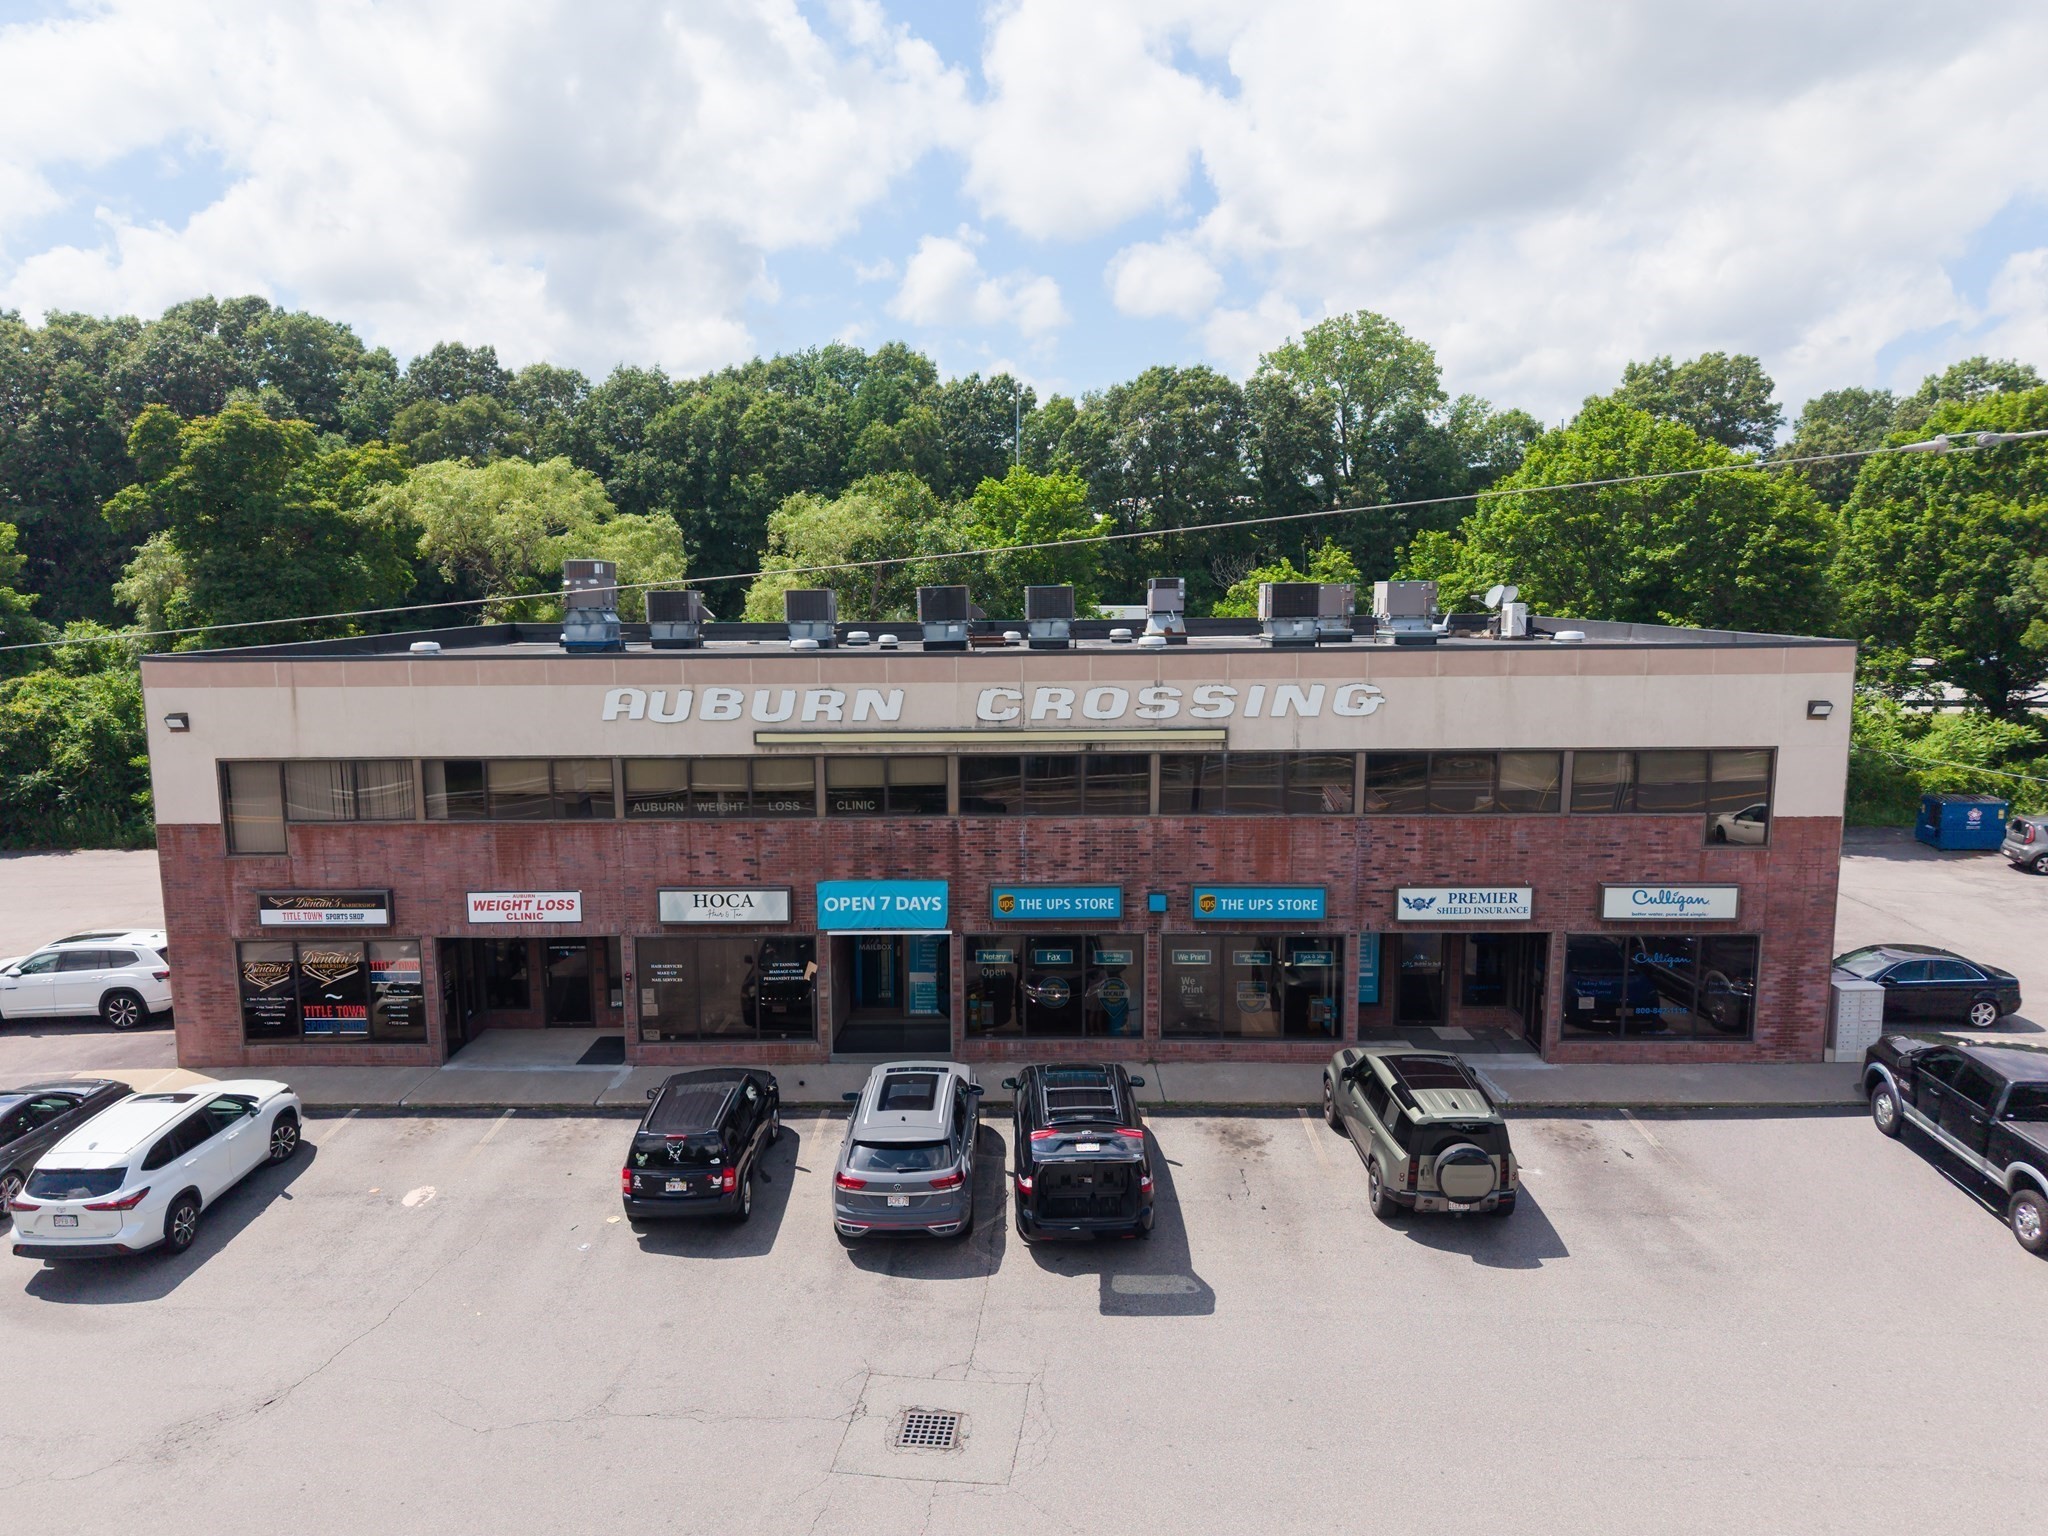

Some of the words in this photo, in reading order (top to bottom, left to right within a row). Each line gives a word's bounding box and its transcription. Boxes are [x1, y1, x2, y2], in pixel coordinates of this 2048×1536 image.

[602, 687, 904, 723] AUBURN
[976, 683, 1386, 721] CROSSING
[633, 802, 684, 812] AUBURN
[697, 802, 744, 812] WEIGHT
[768, 801, 800, 811] LOSS
[836, 800, 876, 810] CLINIC
[294, 896, 342, 908] Duncan's
[693, 893, 754, 908] HOCA
[824, 896, 875, 912] OPEN
[880, 896, 891, 911] 7
[896, 896, 942, 911] DAYS
[1020, 898, 1042, 910] THE
[1046, 898, 1071, 910] UPS
[1076, 898, 1114, 910] STORE
[1448, 892, 1518, 904] PREMIER
[1632, 890, 1709, 912] Culligan
[474, 900, 532, 911] WEIGHT
[537, 900, 575, 910] LOSS
[1221, 899, 1244, 910] THE
[1248, 899, 1273, 910] UPS
[1278, 899, 1318, 910] STORE
[1474, 906, 1528, 914] INSURANCE
[282, 912, 300, 920] TITLE
[303, 912, 323, 920] TOWN
[706, 908, 724, 919] Hair
[730, 908, 743, 918] Tan
[300, 950, 362, 964] Duncan's
[983, 953, 1006, 962] Notary
[1634, 952, 1690, 968] Culligan
[243, 962, 292, 974] Duncan's
[395, 961, 420, 971] TOWN
[982, 968, 1006, 978] Open
[1181, 976, 1196, 985] We
[1182, 985, 1203, 994] Print
[304, 1006, 333, 1018] TITLE
[336, 1006, 366, 1018] TOWN
[305, 1021, 340, 1030] SPORTS
[343, 1020, 366, 1030] SHOP
